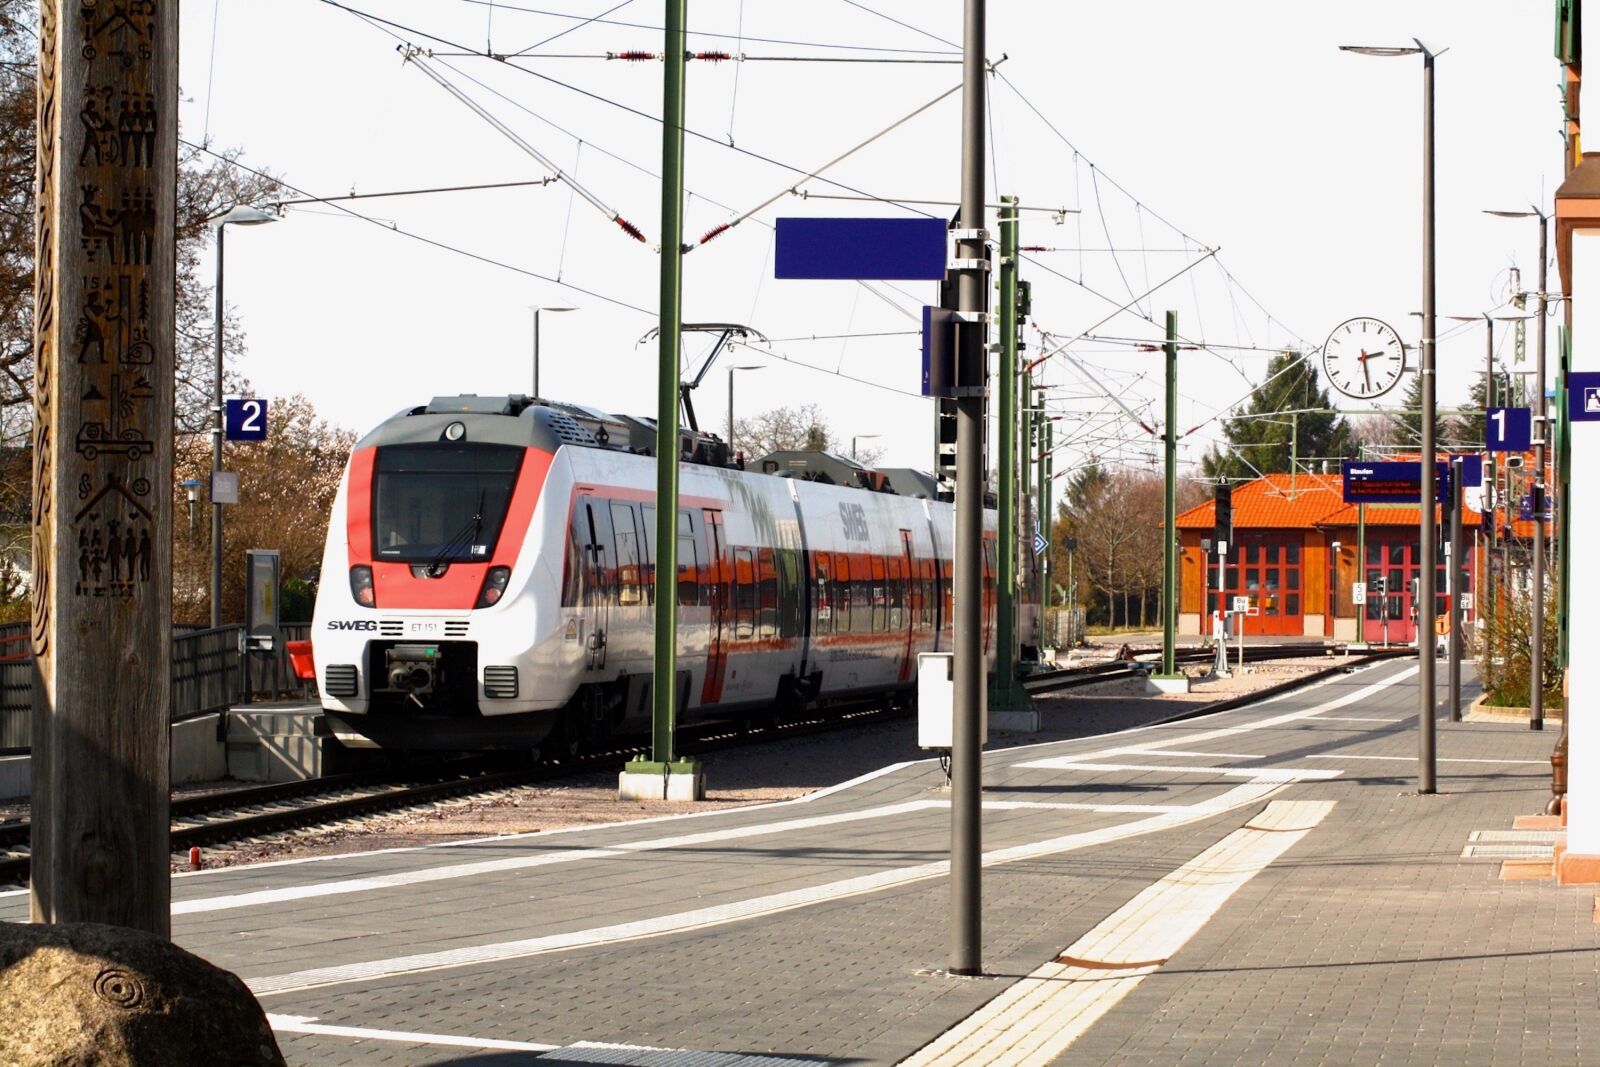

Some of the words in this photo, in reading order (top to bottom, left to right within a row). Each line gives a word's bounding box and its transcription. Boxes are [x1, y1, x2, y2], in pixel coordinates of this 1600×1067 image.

[241, 401, 261, 432] 2
[1491, 409, 1505, 441] 1
[838, 501, 869, 541] SWEG
[327, 620, 377, 631] SWEG
[411, 623, 422, 631] ET
[424, 623, 437, 631] 151
